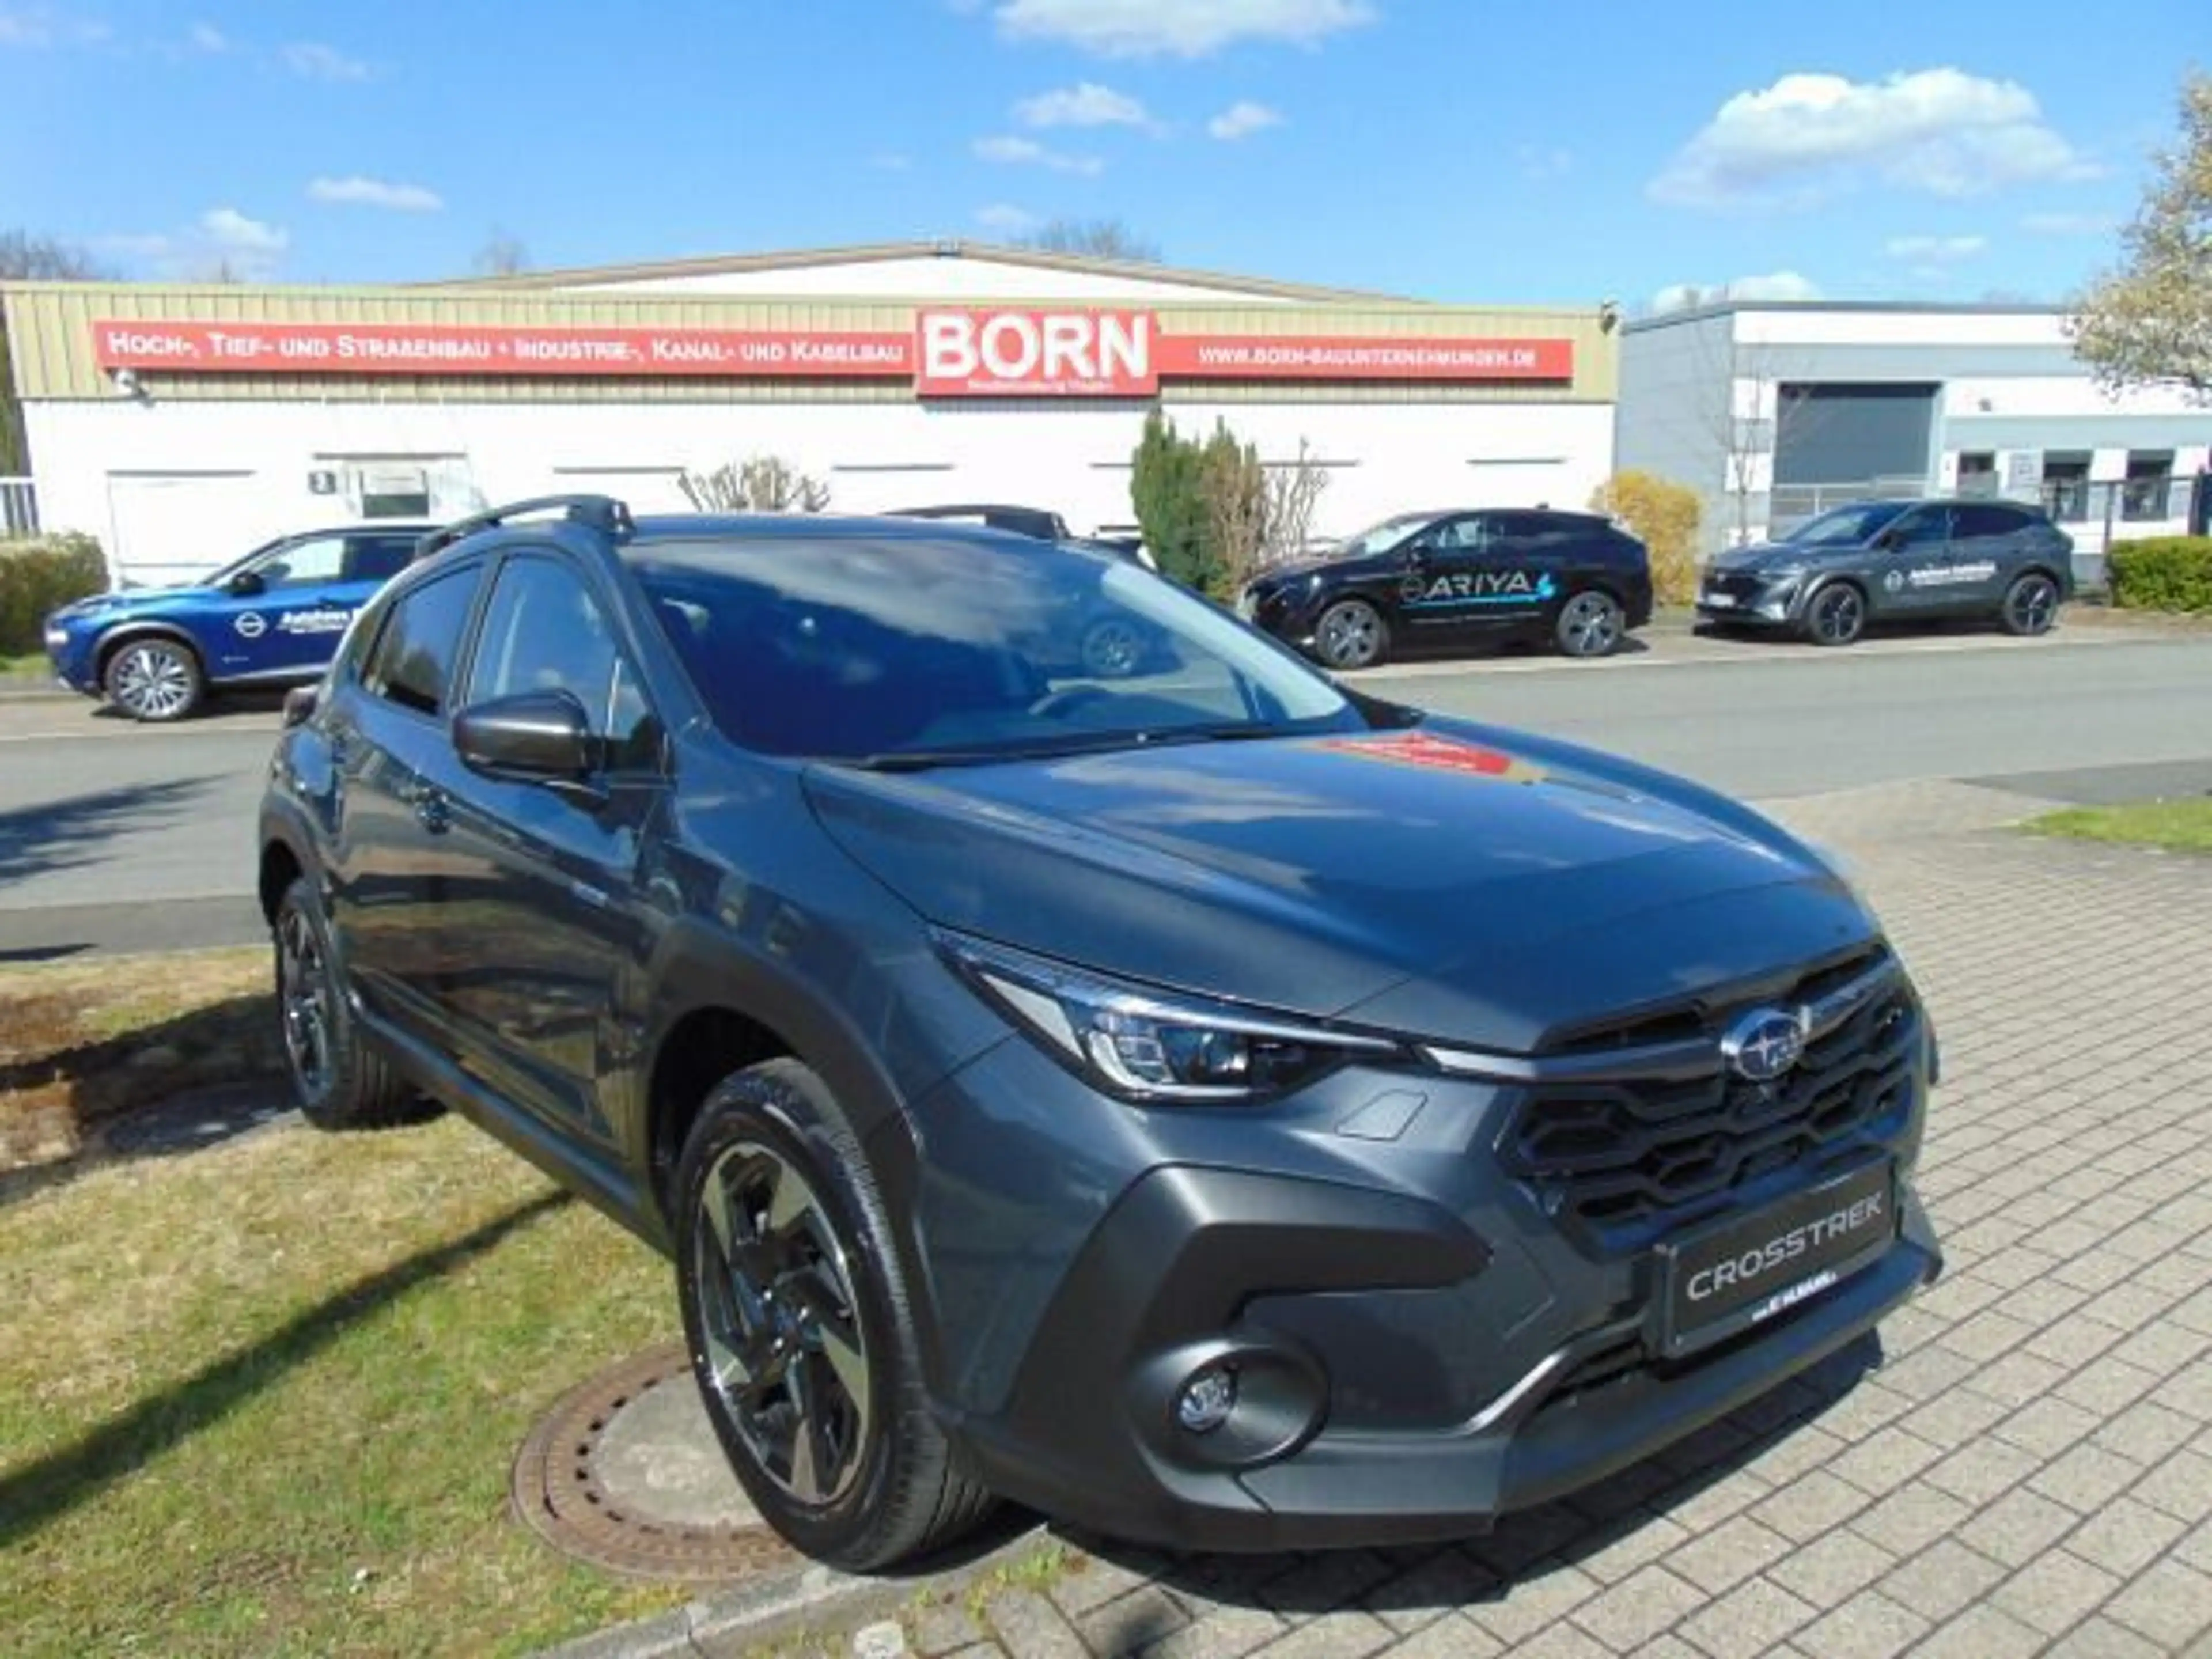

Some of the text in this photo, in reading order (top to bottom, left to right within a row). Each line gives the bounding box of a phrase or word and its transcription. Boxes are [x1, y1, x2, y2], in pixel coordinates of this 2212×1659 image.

[207, 332, 274, 356] TIEF-
[280, 335, 330, 357] UND
[652, 338, 734, 361] KANAL-
[741, 341, 781, 361] UND
[791, 340, 904, 362] KABELBAU
[923, 313, 1149, 378] BORN
[1424, 570, 1532, 600] ARIYA
[1686, 1190, 1883, 1301] CROSSTREK
